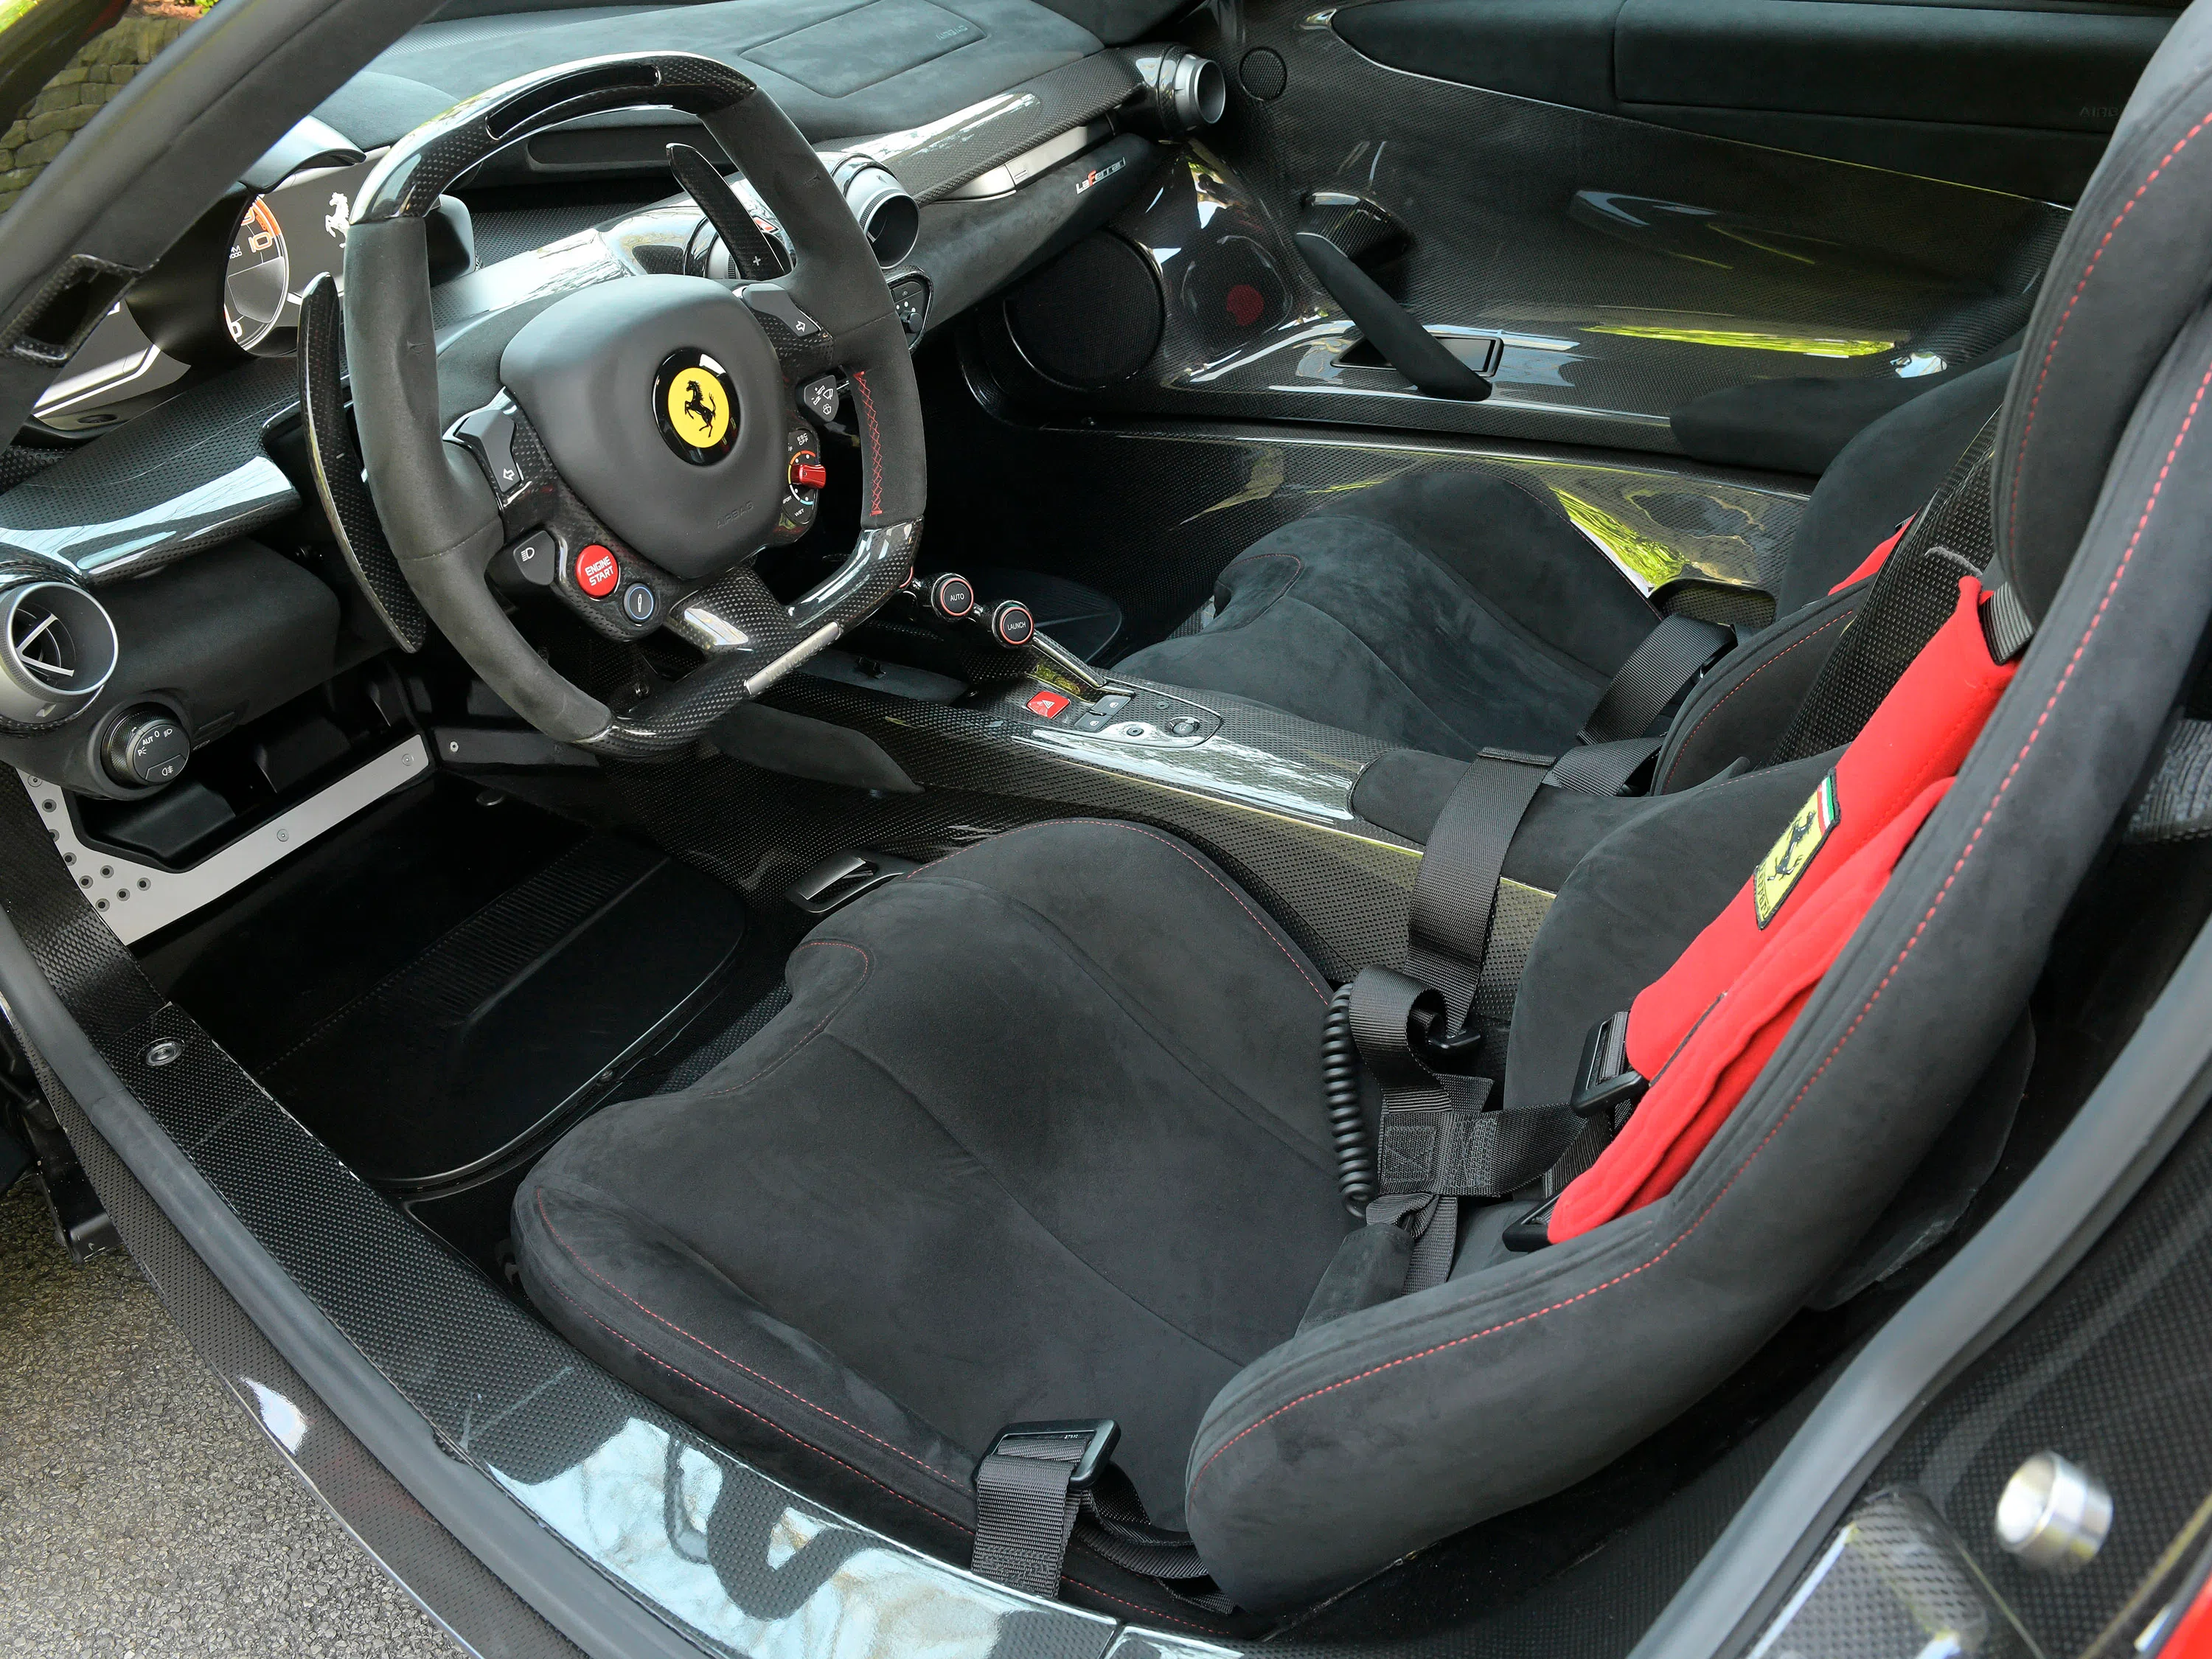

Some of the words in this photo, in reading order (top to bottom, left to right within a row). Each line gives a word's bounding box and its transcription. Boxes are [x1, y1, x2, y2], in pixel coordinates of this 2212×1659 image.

[248, 232, 273, 253] 10
[799, 437, 809, 446] OFF
[794, 508, 804, 517] WET
[585, 555, 611, 577] ENGINE
[589, 566, 614, 586] START
[950, 593, 965, 602] AUTO
[1007, 621, 1026, 631] LAUNCH
